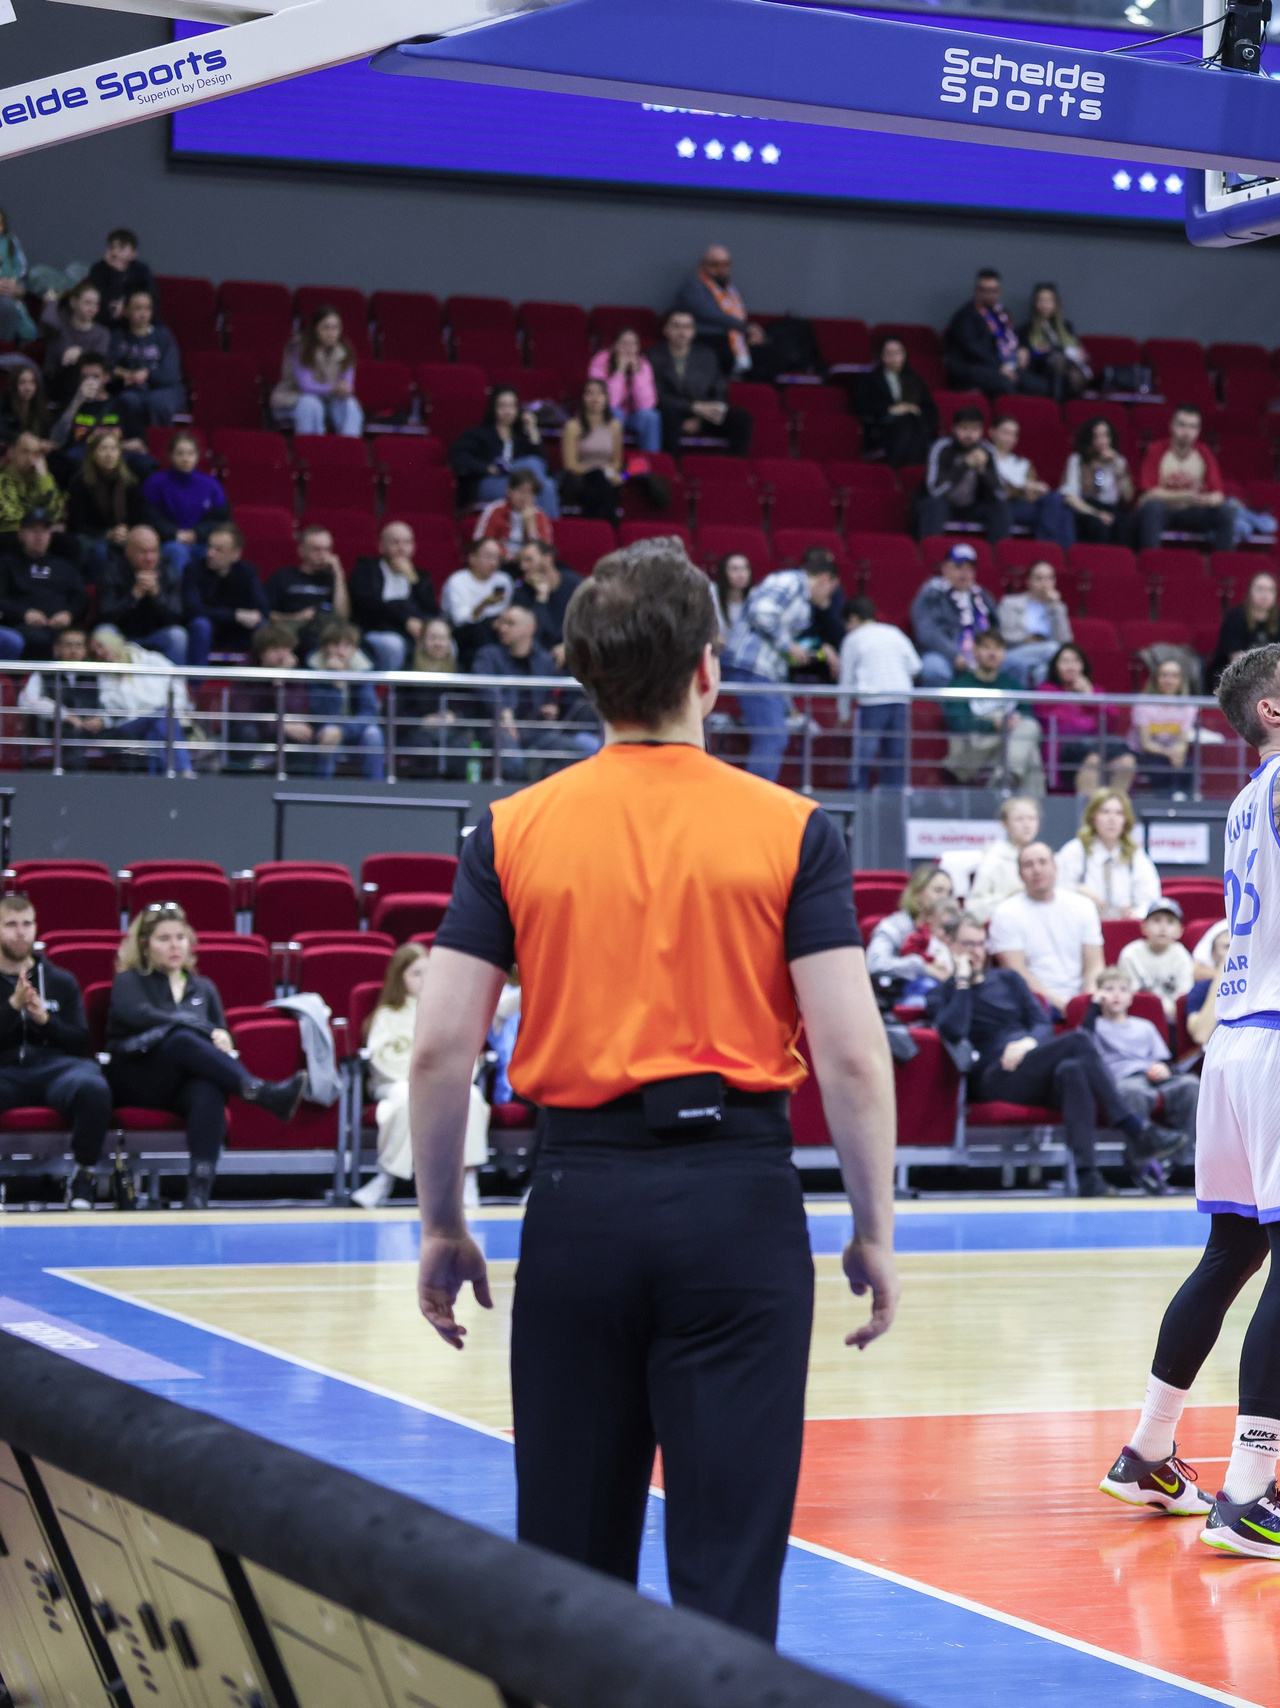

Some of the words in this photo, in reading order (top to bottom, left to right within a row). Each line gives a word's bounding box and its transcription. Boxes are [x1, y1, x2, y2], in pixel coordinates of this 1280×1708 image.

[0, 88, 88, 127] elde
[96, 49, 227, 101] Sports
[137, 85, 180, 105] Superior
[182, 81, 195, 94] by
[197, 72, 232, 90] Design
[942, 47, 1106, 94] Schelde
[939, 75, 1102, 121] Sports
[1223, 954, 1249, 973] AR
[1248, 1429, 1278, 1438] NIKE
